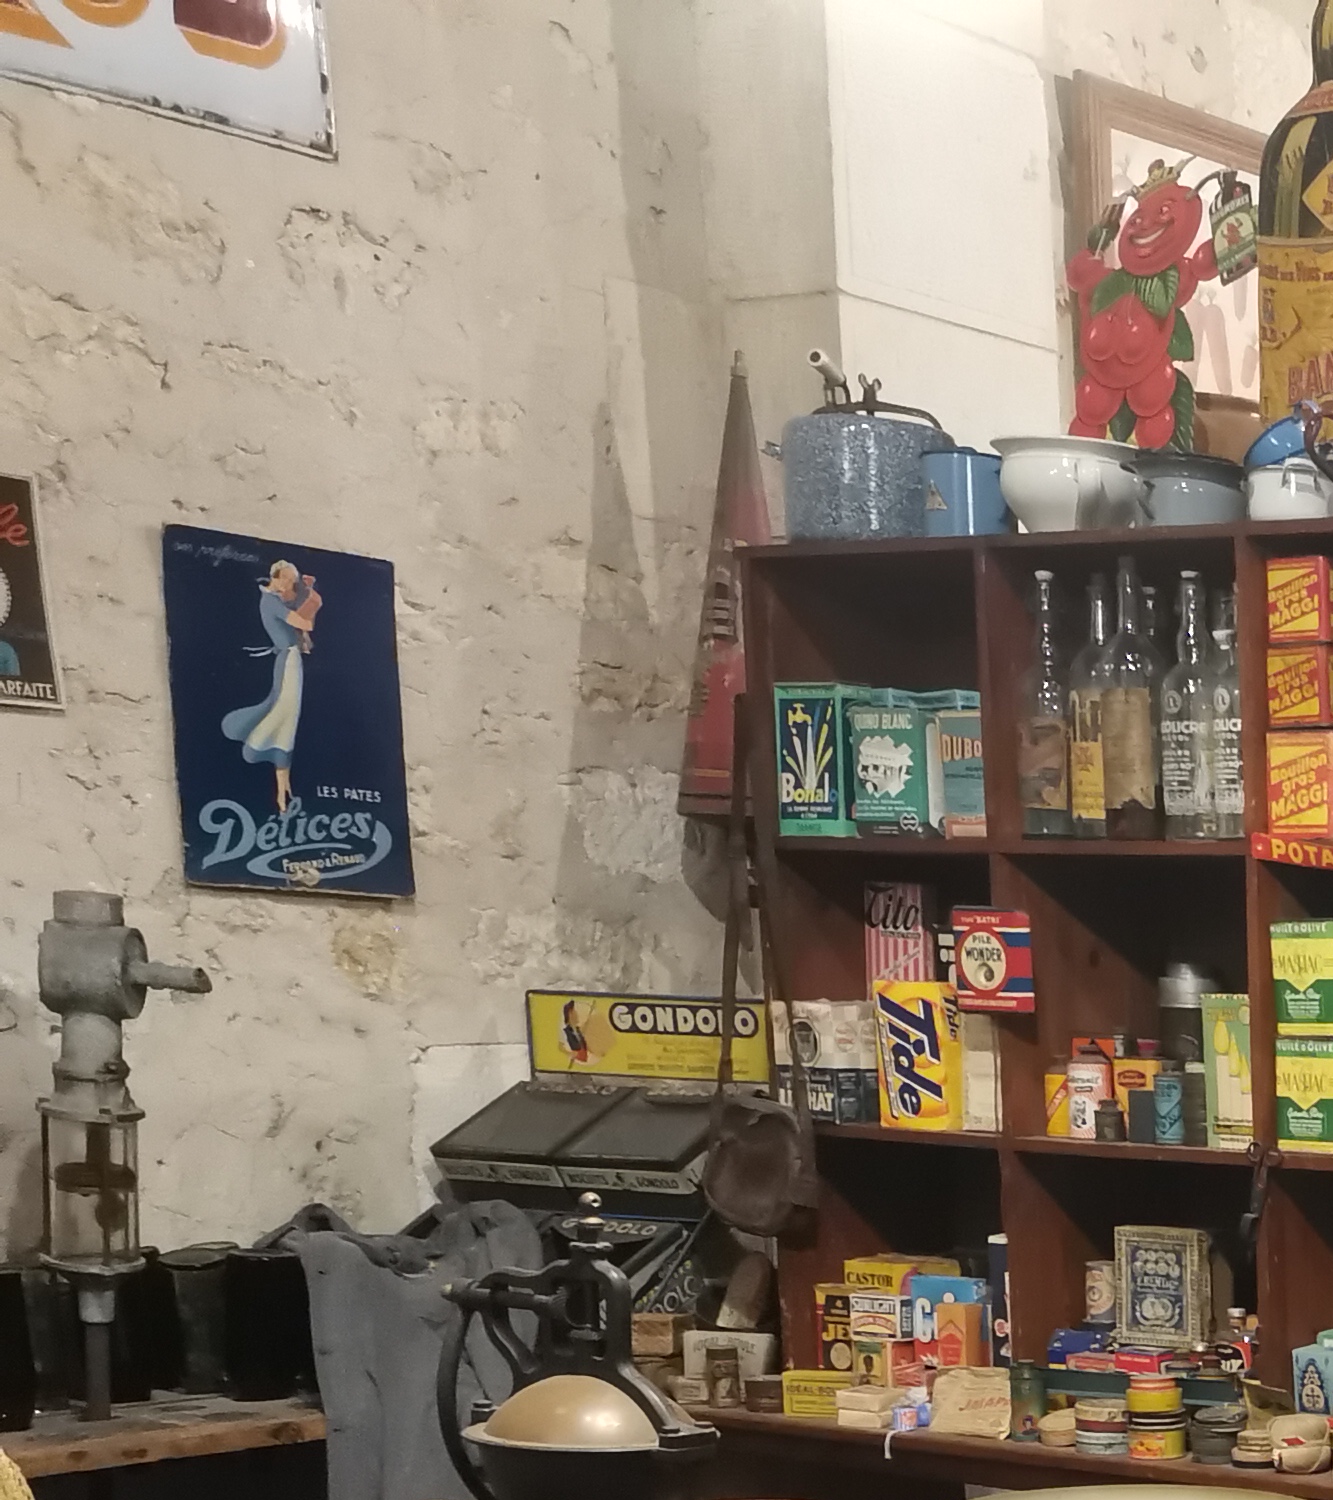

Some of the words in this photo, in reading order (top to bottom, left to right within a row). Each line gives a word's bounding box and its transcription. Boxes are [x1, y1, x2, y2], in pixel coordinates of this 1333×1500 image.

[1269, 595, 1319, 629] MAGGI
[1269, 682, 1319, 713] MAGGI
[316, 785, 339, 799] LES
[344, 787, 382, 803] PATES
[1271, 781, 1328, 822] MAGGI
[198, 795, 373, 871] Délices
[964, 946, 1003, 963] WONDER
[611, 1003, 757, 1037] GONDOO
[876, 991, 943, 1118] Tide
[846, 1271, 893, 1288] CASTOR
